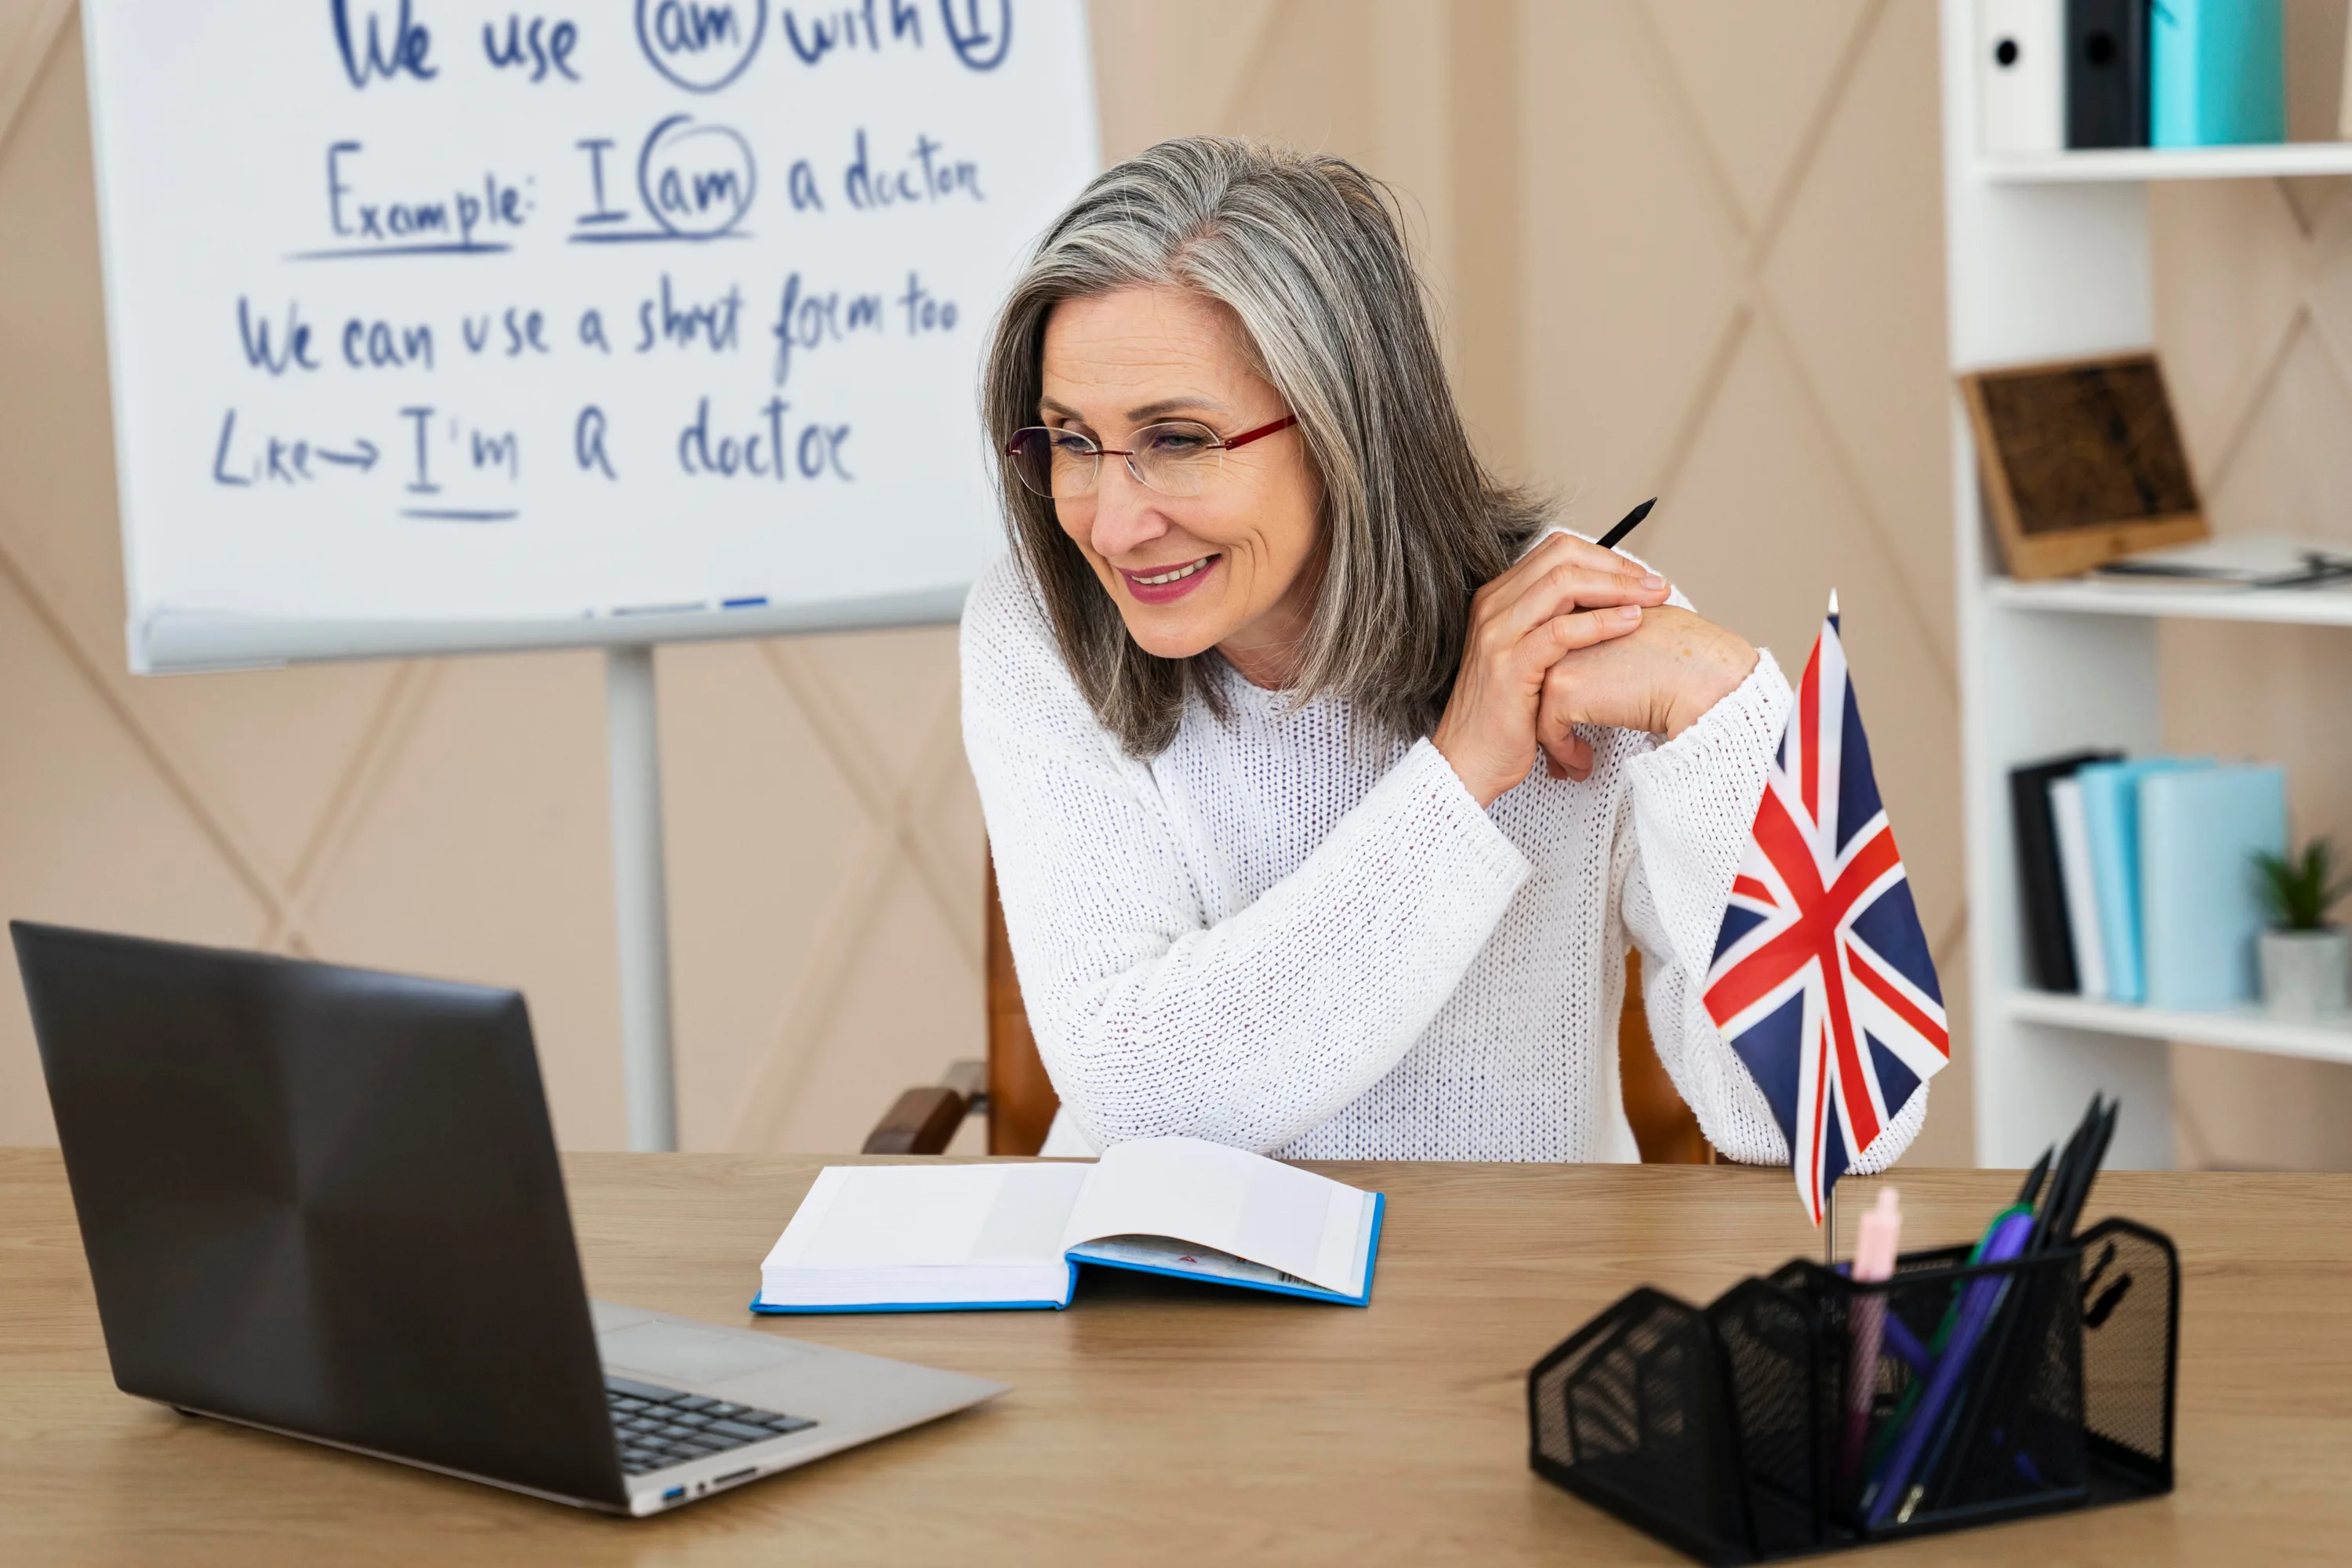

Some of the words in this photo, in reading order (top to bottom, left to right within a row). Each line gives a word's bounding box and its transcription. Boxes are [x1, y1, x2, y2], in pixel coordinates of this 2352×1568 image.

[327, 0, 441, 91] We
[481, 12, 583, 85] use
[654, 0, 740, 56] am
[782, 0, 924, 67] with
[325, 140, 535, 247] Example:
[574, 137, 630, 227] I
[655, 163, 741, 217] am
[786, 158, 825, 213] a
[843, 127, 985, 211] doctor
[236, 295, 321, 377] We
[340, 317, 435, 371] can
[461, 307, 550, 358] use
[577, 307, 612, 355] a
[634, 272, 745, 354] short
[771, 271, 884, 388] form
[897, 271, 960, 336] too
[398, 405, 519, 496] I'm
[677, 394, 852, 483] doctor
